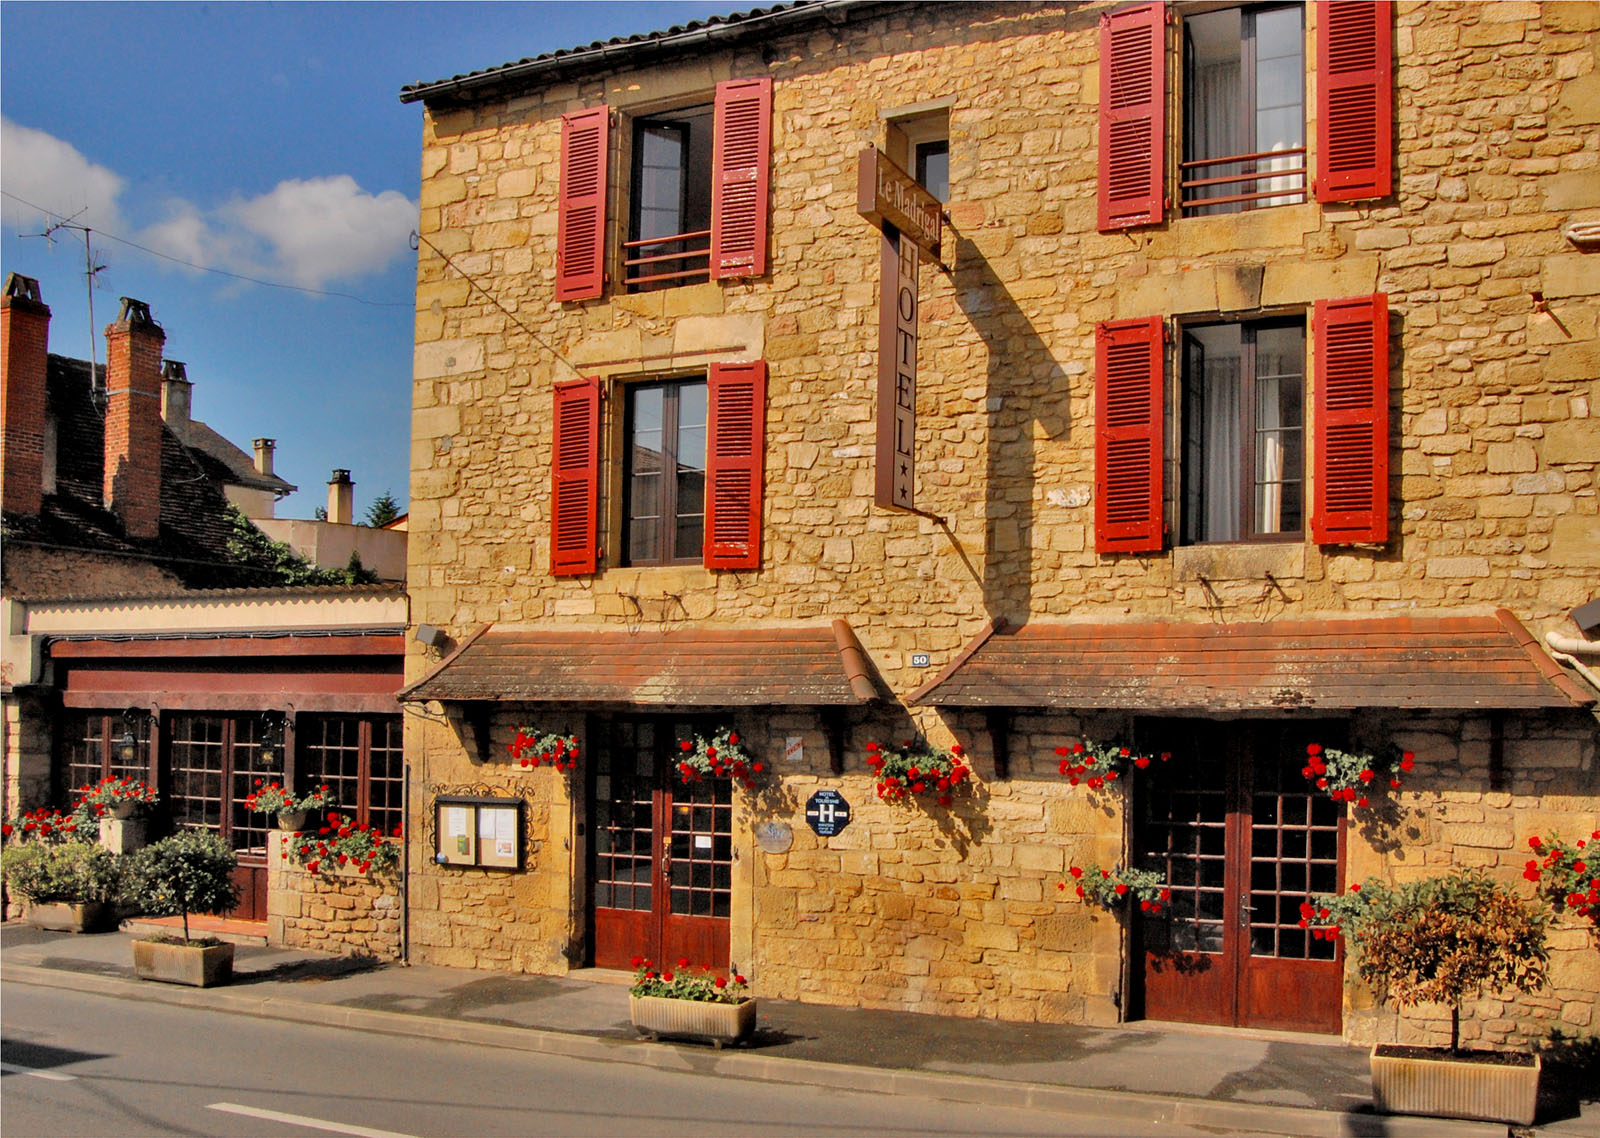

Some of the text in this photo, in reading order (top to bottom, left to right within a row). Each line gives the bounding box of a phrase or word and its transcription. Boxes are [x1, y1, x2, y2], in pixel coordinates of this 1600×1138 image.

[878, 167, 939, 242] Le Madrigal
[897, 240, 915, 457] HOTEL
[913, 656, 927, 664] 50
[819, 804, 834, 822] H
